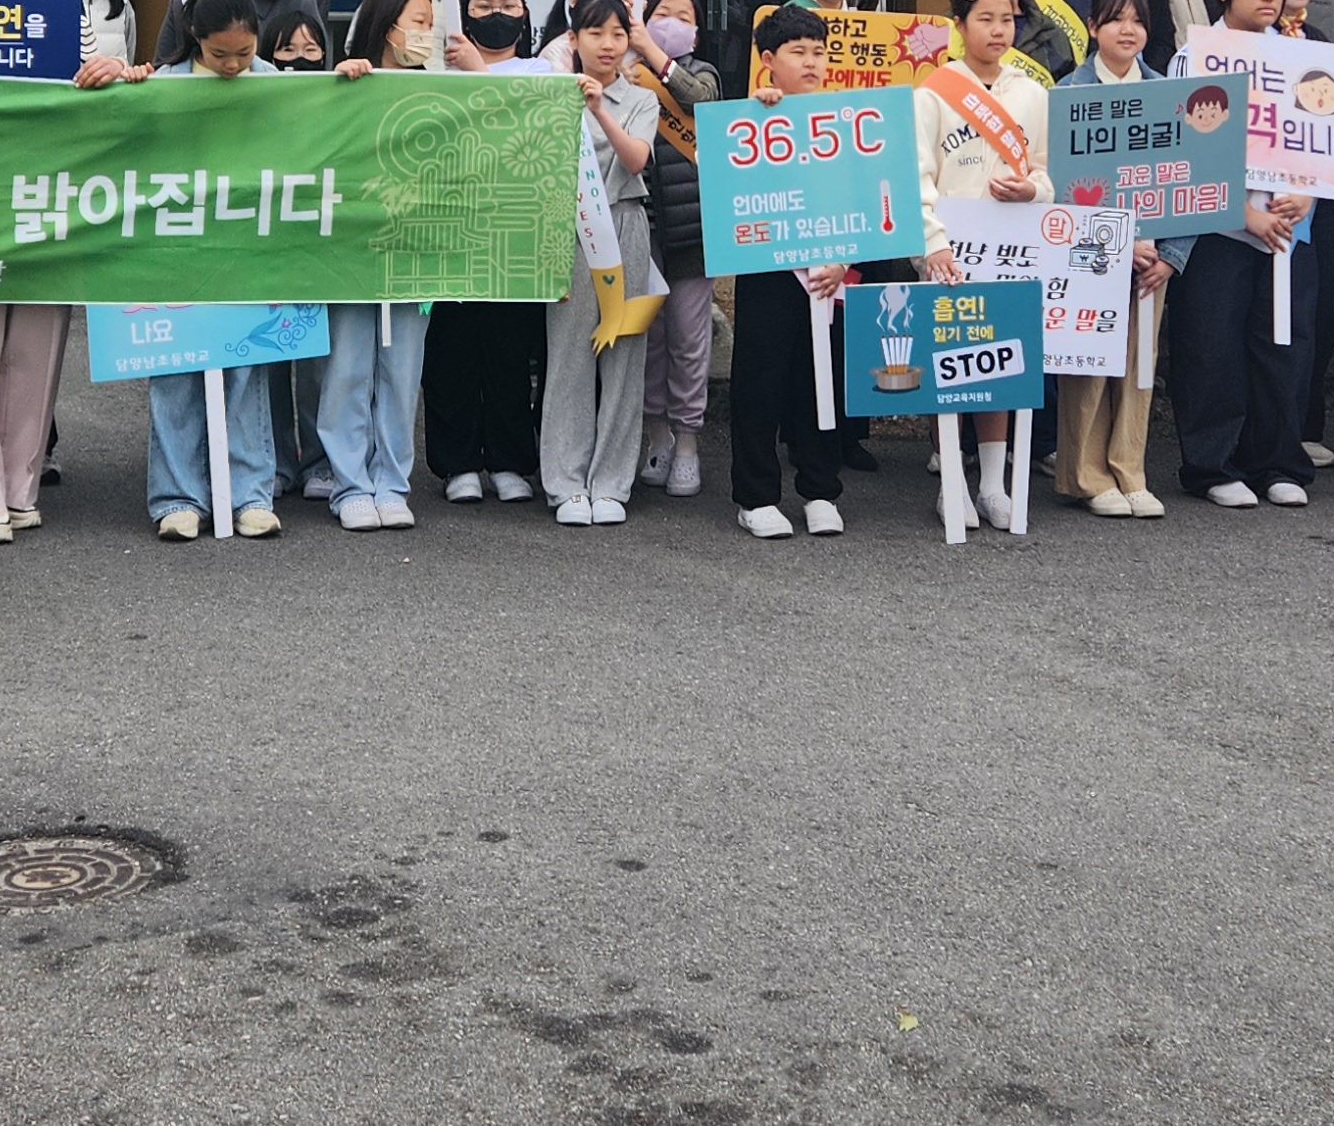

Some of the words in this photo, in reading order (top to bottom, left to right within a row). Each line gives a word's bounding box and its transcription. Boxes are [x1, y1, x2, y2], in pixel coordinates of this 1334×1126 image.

[824, 16, 867, 38] 하고
[851, 41, 892, 67] 행동,
[1070, 100, 1104, 123] 바른
[1110, 98, 1144, 120] 말은
[1070, 127, 1117, 156] 나의
[1128, 121, 1182, 151] 얼굴!
[1117, 166, 1152, 187] 고운
[1156, 161, 1191, 184] 말은
[11, 168, 343, 244] 밝아집니다
[732, 189, 806, 217] 언어에도
[1117, 188, 1165, 220] 나의
[1174, 182, 1229, 214] 마음!
[734, 221, 791, 245] 온도가
[795, 213, 872, 239] 있습니다.
[1048, 215, 1067, 239] 말
[773, 244, 859, 265] 담양남초등학교
[996, 244, 1041, 269] 빚도
[1046, 276, 1069, 300] 힘
[932, 296, 985, 322] 흡연!
[1045, 306, 1066, 330] 운
[1075, 308, 1117, 333] 말을
[130, 319, 174, 345] 나요
[967, 325, 994, 341] 전에
[115, 350, 211, 372] 담양남초등학교
[940, 346, 1014, 381] STOP
[1043, 353, 1107, 368] 양남초등학교
